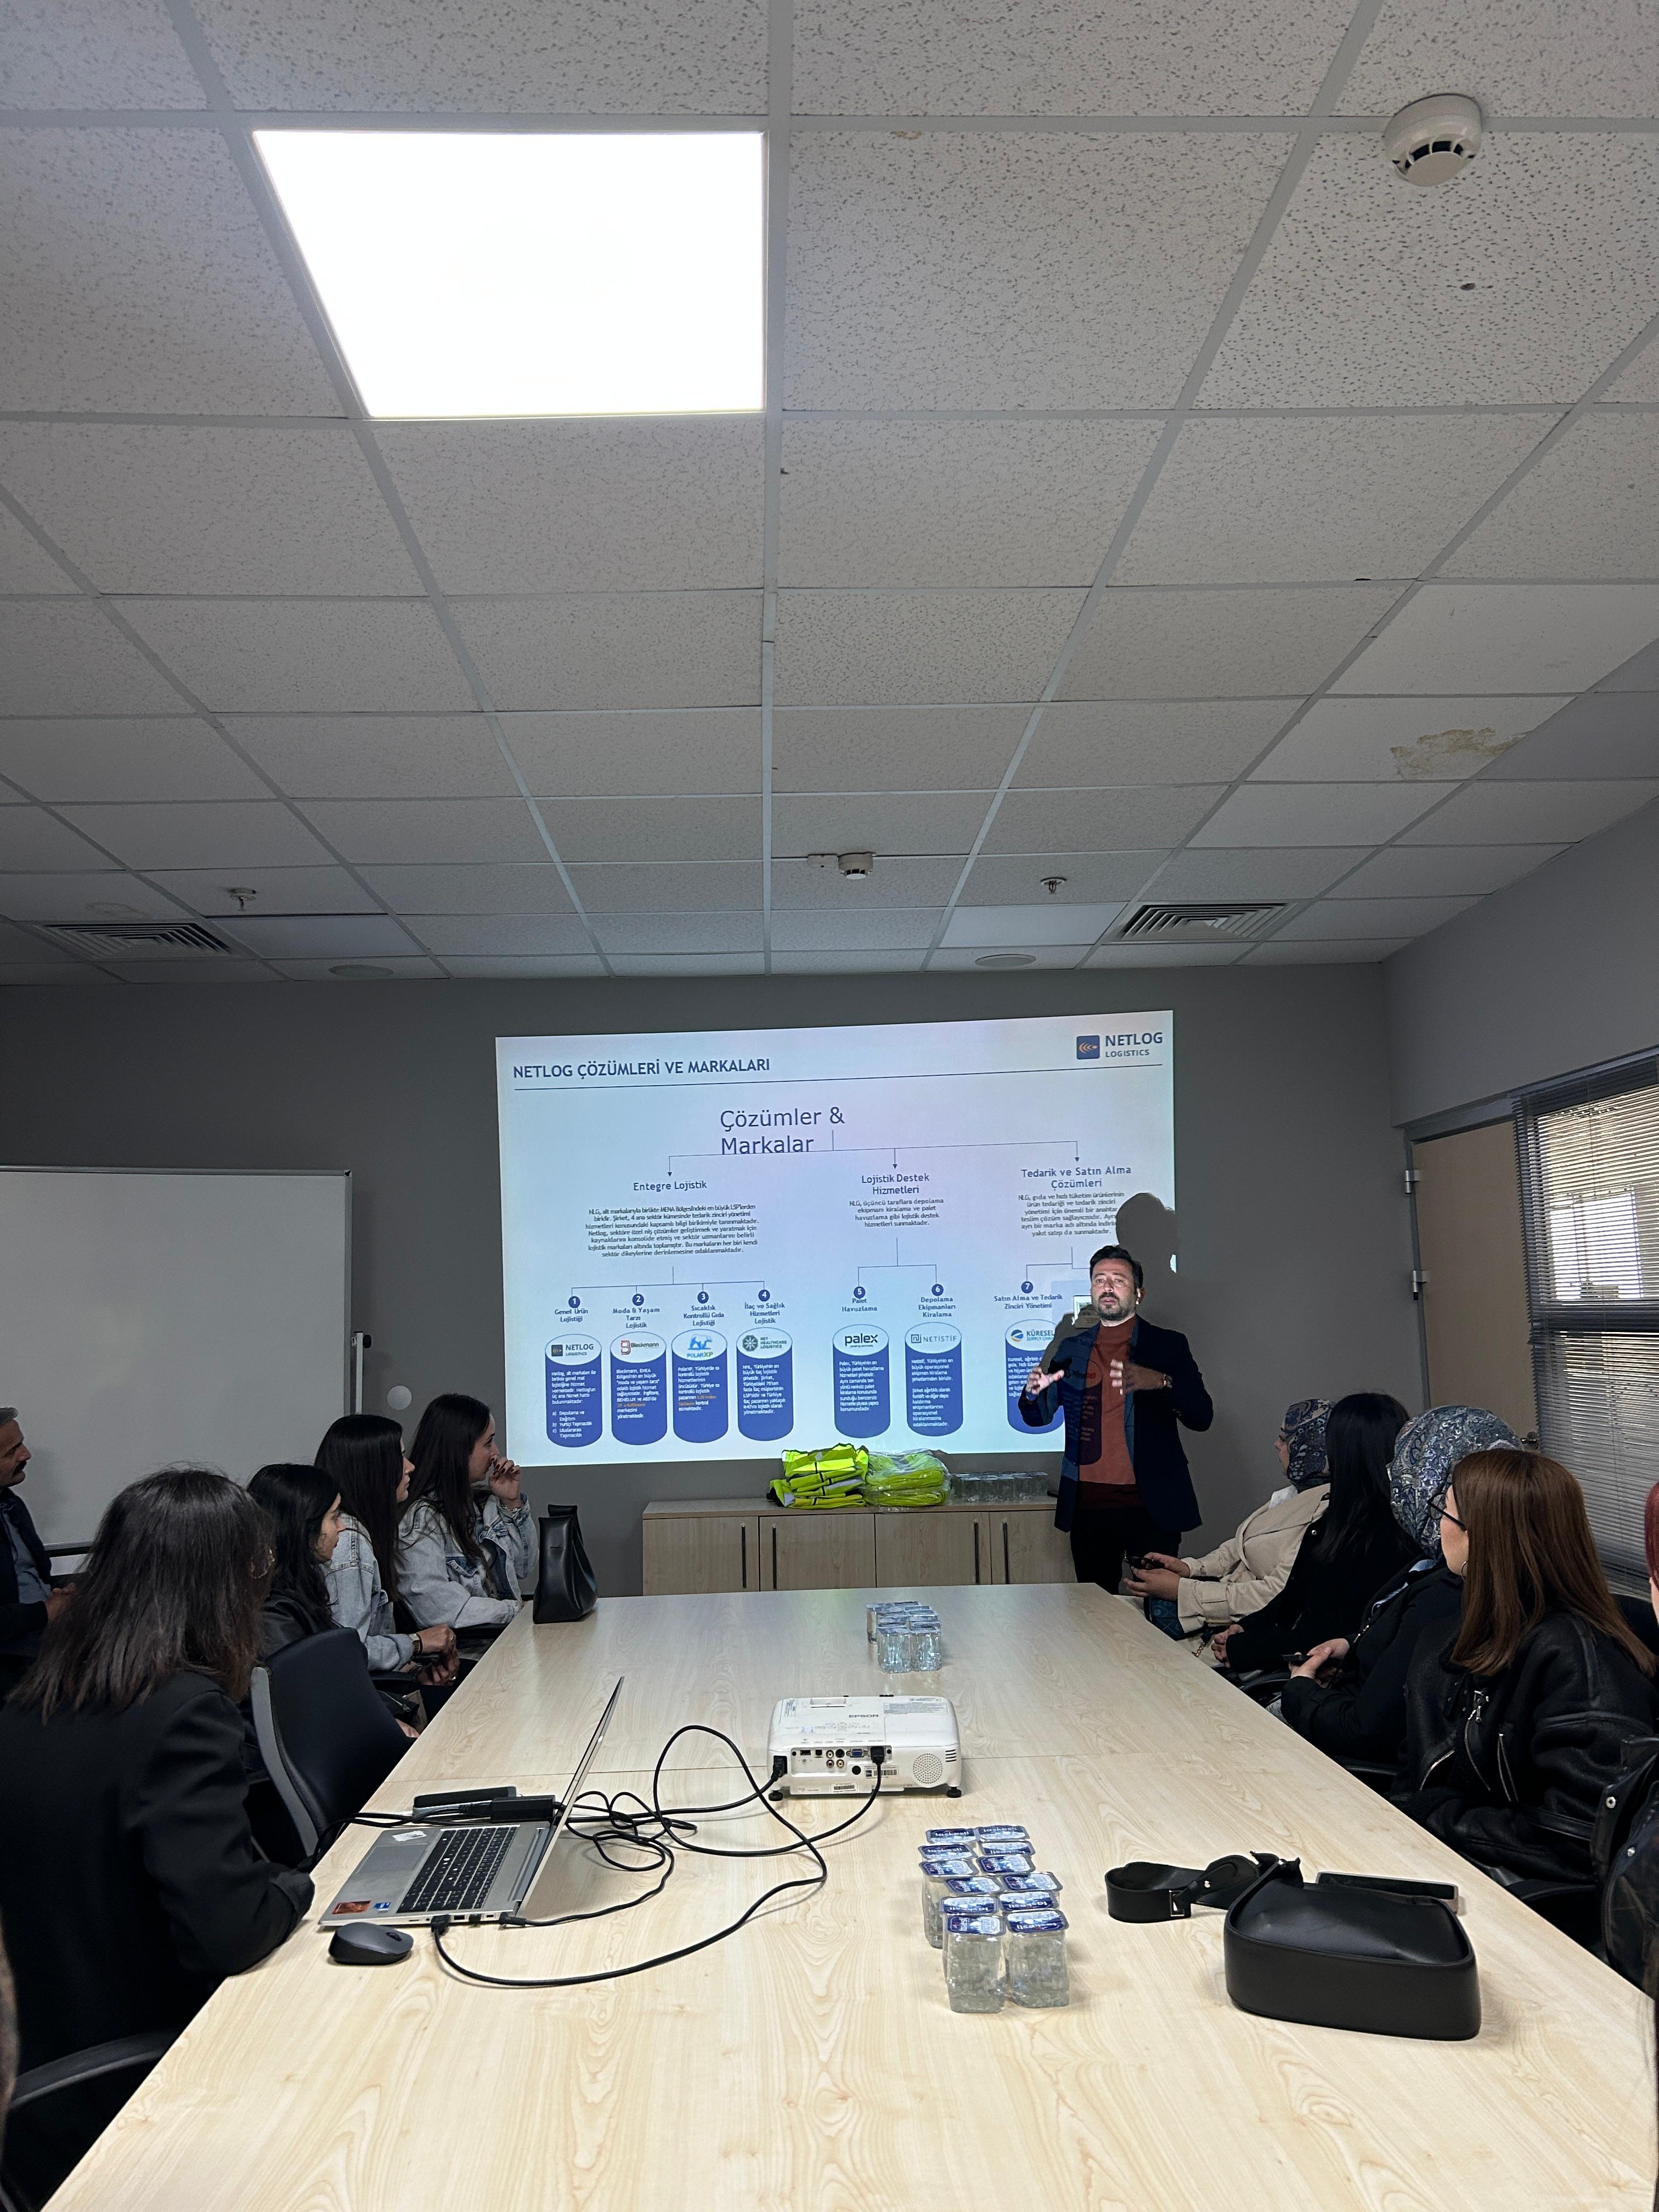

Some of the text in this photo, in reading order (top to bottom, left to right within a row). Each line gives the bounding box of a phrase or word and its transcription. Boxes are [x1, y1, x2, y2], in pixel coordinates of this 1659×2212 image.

[1105, 1032, 1163, 1047] NETLOG
[1105, 1049, 1149, 1058] LOGISTICS
[514, 1059, 769, 1080] NETLOG ÇÖZÜMLERİ VE MARKALARI
[721, 1107, 845, 1132] Çözümler &
[721, 1136, 814, 1154] Markalar
[1021, 1169, 1057, 1177] Tedarik
[1075, 1167, 1102, 1176] Satın
[861, 1173, 929, 1185] Lojistik Destek
[1051, 1178, 1102, 1191] Çözümleri
[634, 1180, 707, 1192] Entegre Lojistik
[873, 1185, 919, 1194] Hizmetleri
[845, 1334, 878, 1346] palex
